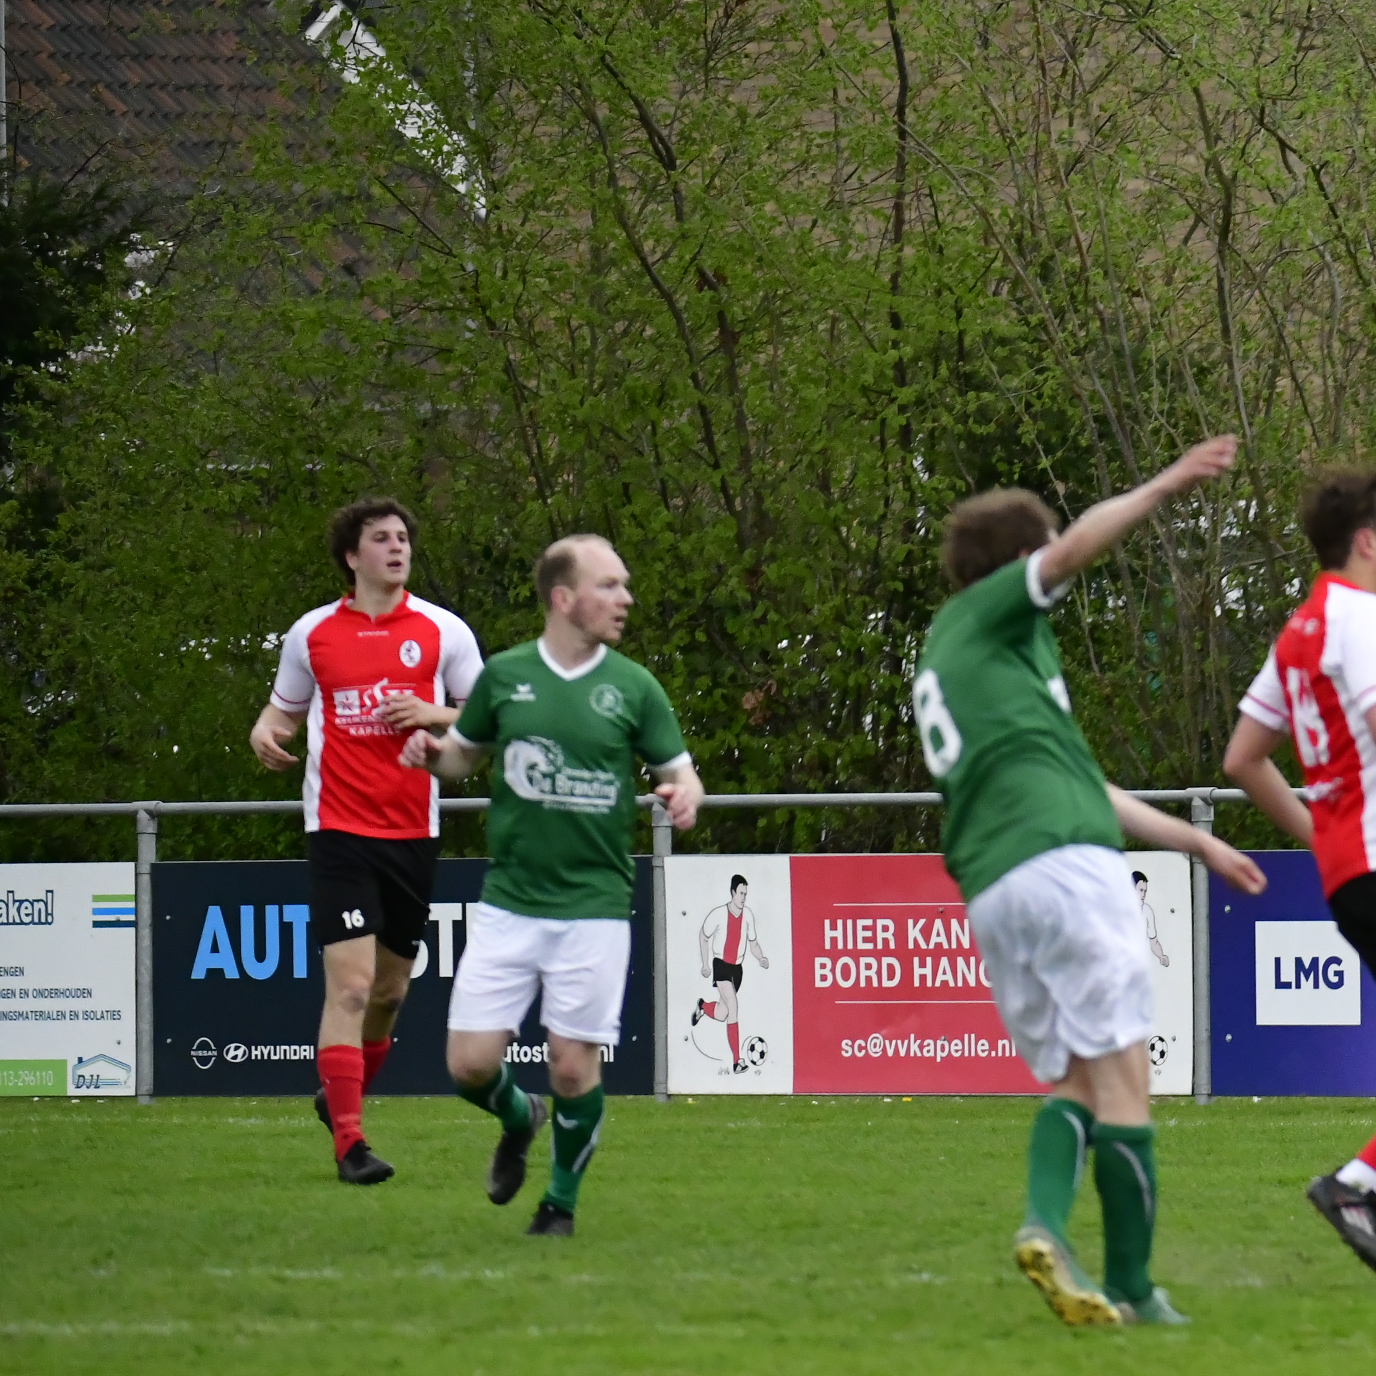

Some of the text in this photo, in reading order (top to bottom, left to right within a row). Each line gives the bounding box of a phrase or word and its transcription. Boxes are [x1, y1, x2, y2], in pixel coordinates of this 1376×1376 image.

[342, 908, 365, 929] 16
[190, 904, 318, 980] AUT
[824, 918, 970, 950] HIER KAN
[814, 956, 902, 988] BORD
[1274, 955, 1345, 990] LMG
[19, 988, 30, 999] EN
[32, 988, 92, 999] ONDERHOUDEN
[69, 1010, 80, 1021] EN
[82, 1010, 122, 1021] ISOLATIES
[251, 1045, 315, 1060] HYUNDAI
[841, 1034, 1017, 1062] sc@vvkapelle.nl
[0, 1070, 54, 1086] 13-296110
[74, 1074, 101, 1089] DJL
